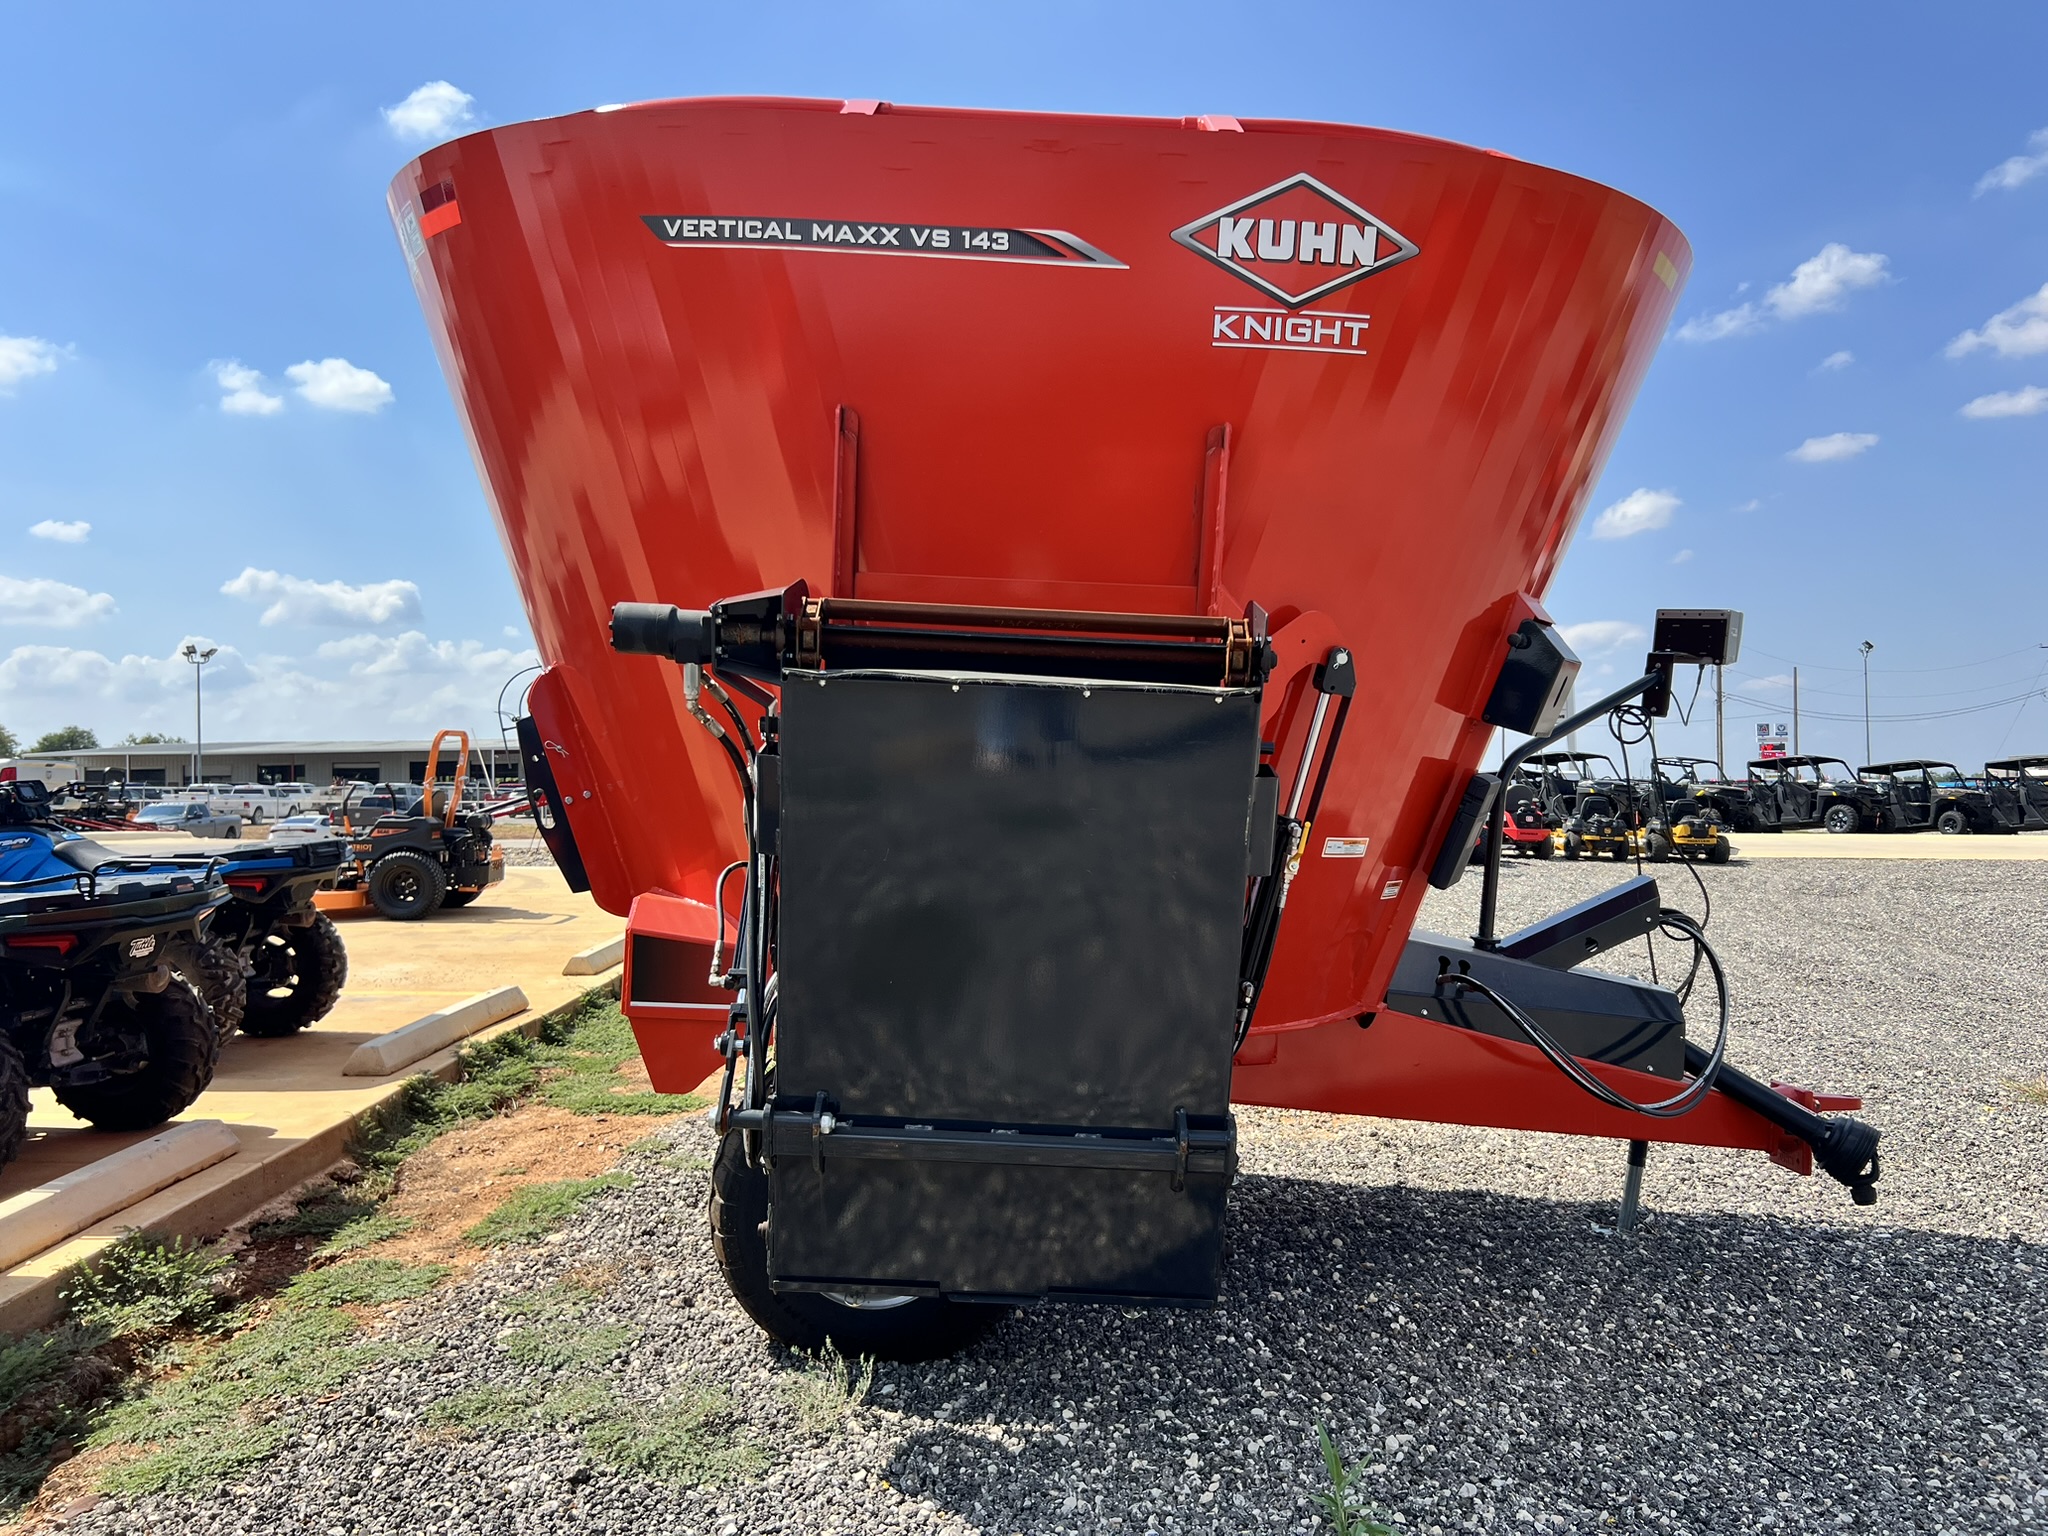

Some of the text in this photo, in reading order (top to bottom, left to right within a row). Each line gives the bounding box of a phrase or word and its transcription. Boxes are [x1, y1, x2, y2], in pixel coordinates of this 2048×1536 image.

[663, 219, 1010, 251] VERTICAL MAXX VS 143
[1217, 217, 1378, 267] KUHN
[1213, 314, 1369, 346] KNIGHT
